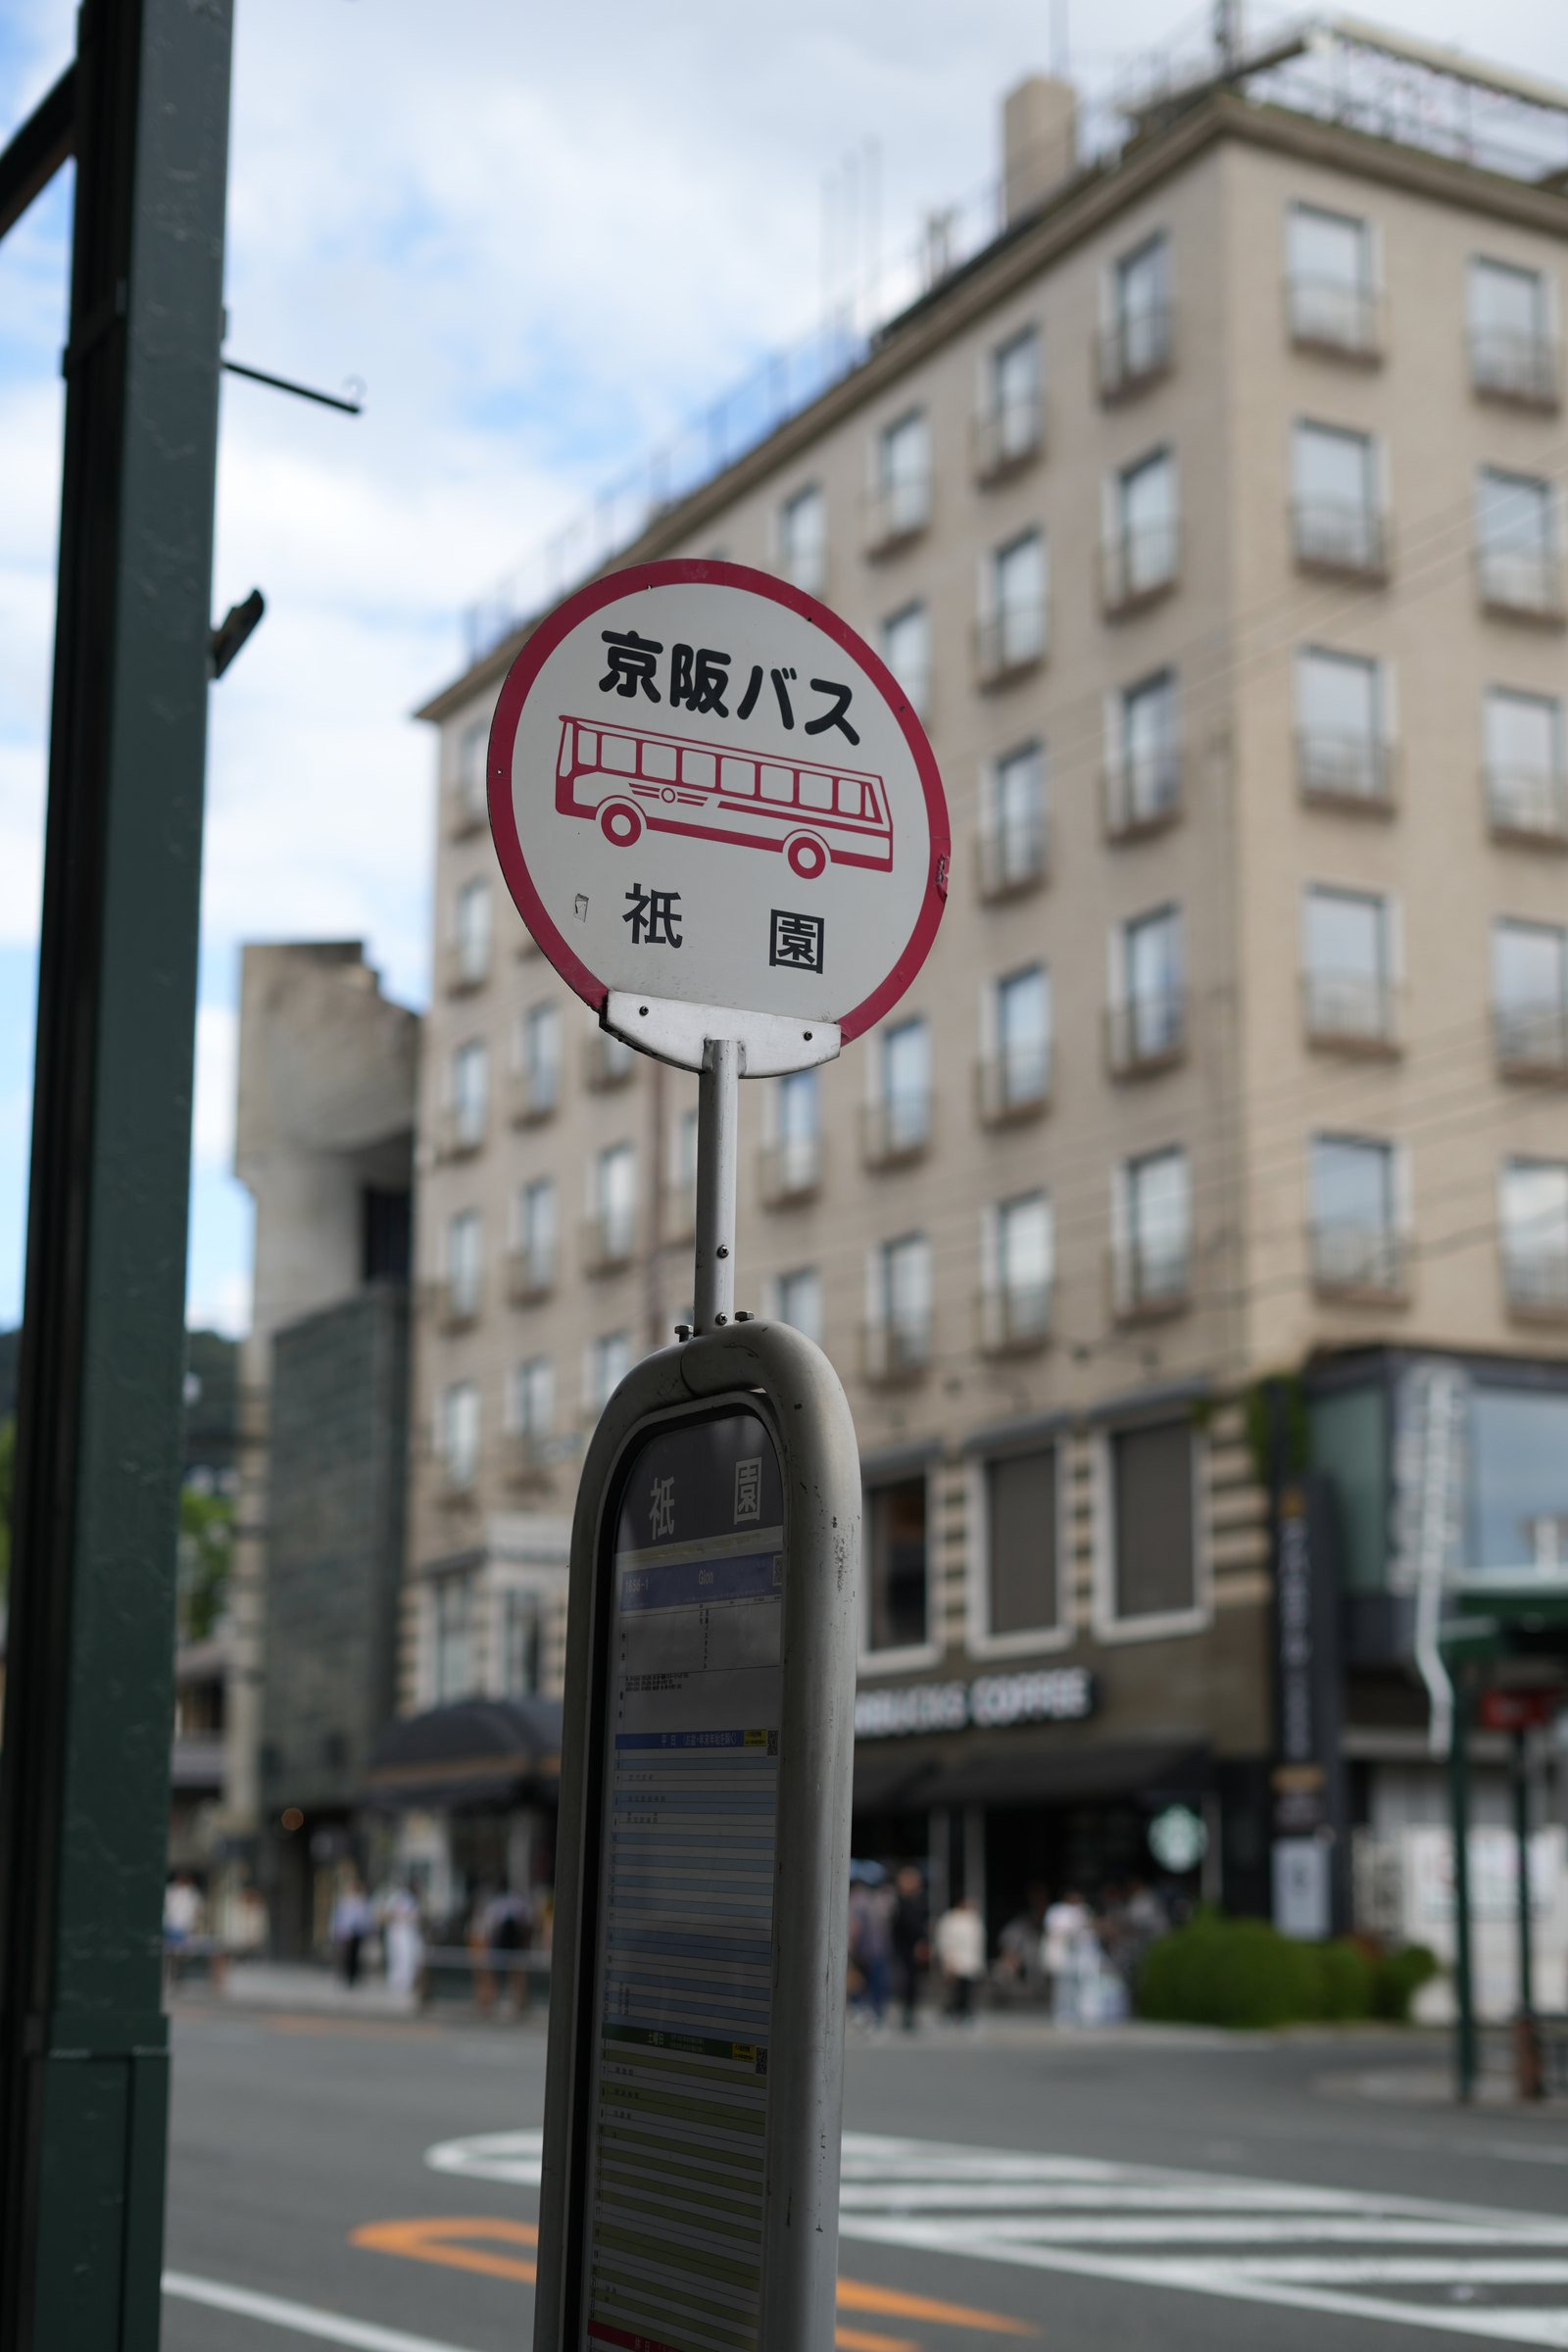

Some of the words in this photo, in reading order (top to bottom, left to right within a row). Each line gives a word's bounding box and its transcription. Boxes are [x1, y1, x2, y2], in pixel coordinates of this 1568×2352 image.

[599, 630, 860, 746] 京阪バス
[698, 1569, 714, 1585] Gion
[970, 1669, 1091, 1725] COFFEE
